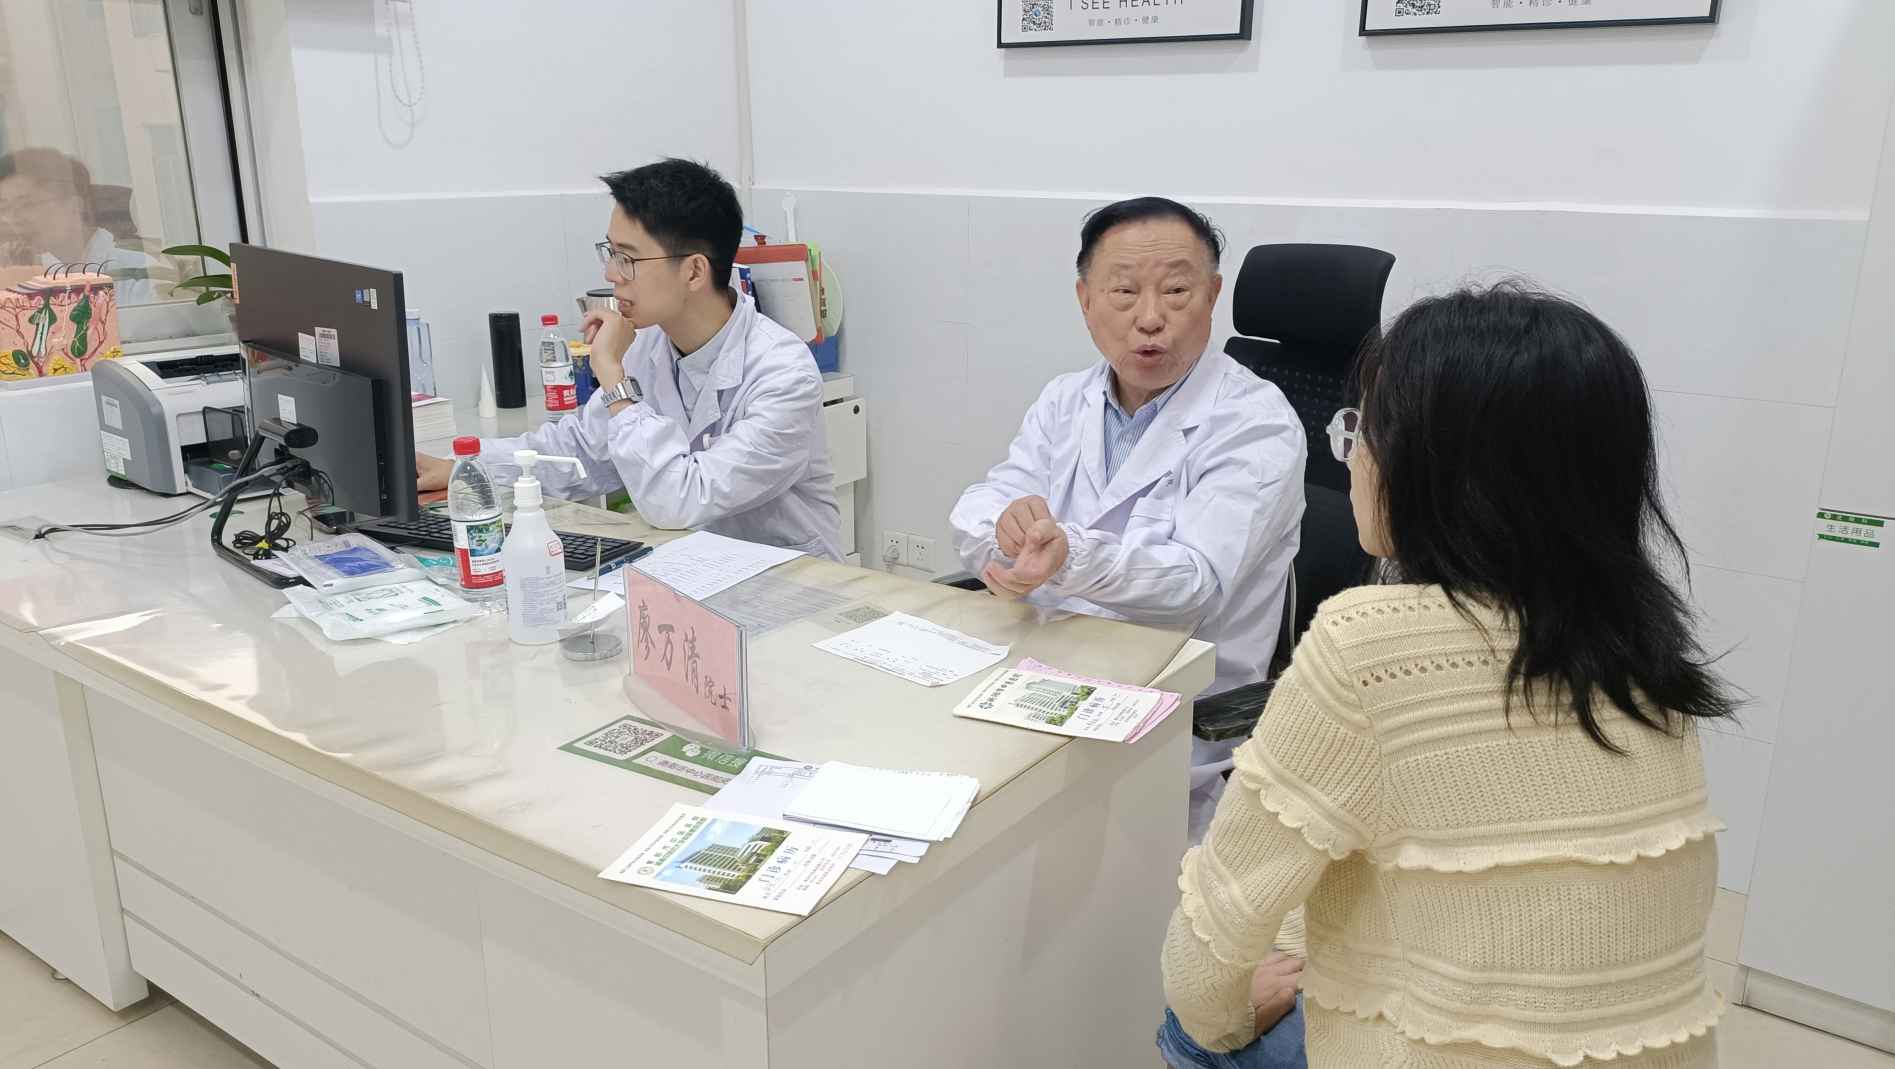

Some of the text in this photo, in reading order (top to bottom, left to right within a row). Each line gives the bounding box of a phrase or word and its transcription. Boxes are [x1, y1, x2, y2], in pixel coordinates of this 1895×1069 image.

[1080, 0, 1111, 10] SEE
[1826, 524, 1874, 537] 生活用品
[758, 845, 799, 884] 门诊病历
